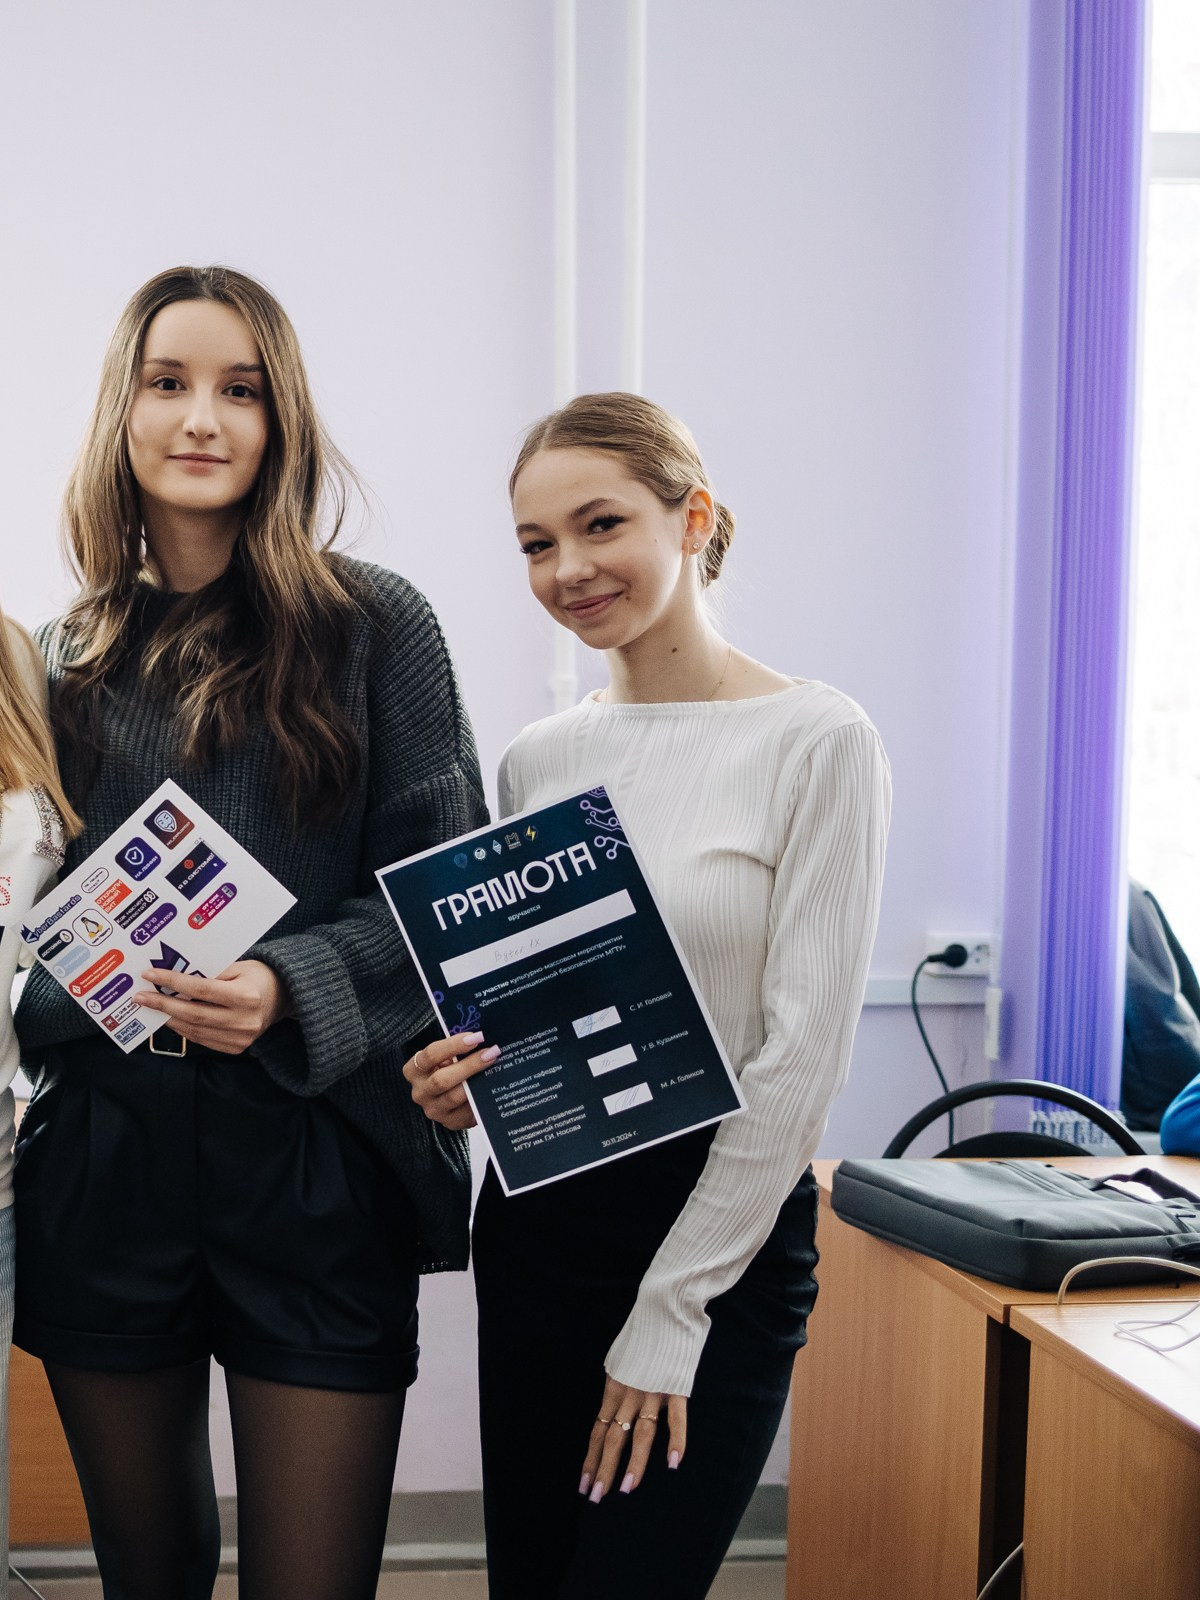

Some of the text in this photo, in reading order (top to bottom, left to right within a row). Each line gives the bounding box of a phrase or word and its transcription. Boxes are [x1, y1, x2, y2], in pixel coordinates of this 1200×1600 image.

[432, 842, 597, 931] ГРАМОТА
[508, 904, 541, 922] вручается
[479, 944, 627, 1008] «День информационной безопасности МГТУ»
[482, 981, 510, 996] участие
[510, 953, 577, 985] культурно-массовом
[577, 935, 623, 957] мероприятии
[520, 1036, 559, 1054] аспирантов
[524, 1027, 559, 1044] профкома
[656, 1030, 689, 1047] Кузьмина
[484, 1066, 503, 1076] МГТУ
[526, 1048, 551, 1060] Носова
[509, 1076, 533, 1088] доцент
[533, 1065, 563, 1080] кафедры
[677, 1068, 705, 1082] Голиков
[495, 1082, 541, 1103] информатики
[504, 1082, 563, 1109] информационной
[508, 1105, 585, 1136] Начальник управления
[511, 1114, 587, 1144] молодежной политики
[514, 1142, 533, 1152] МГТУ
[556, 1124, 581, 1137] Носова
[601, 1132, 633, 1148] 30.11.2024
